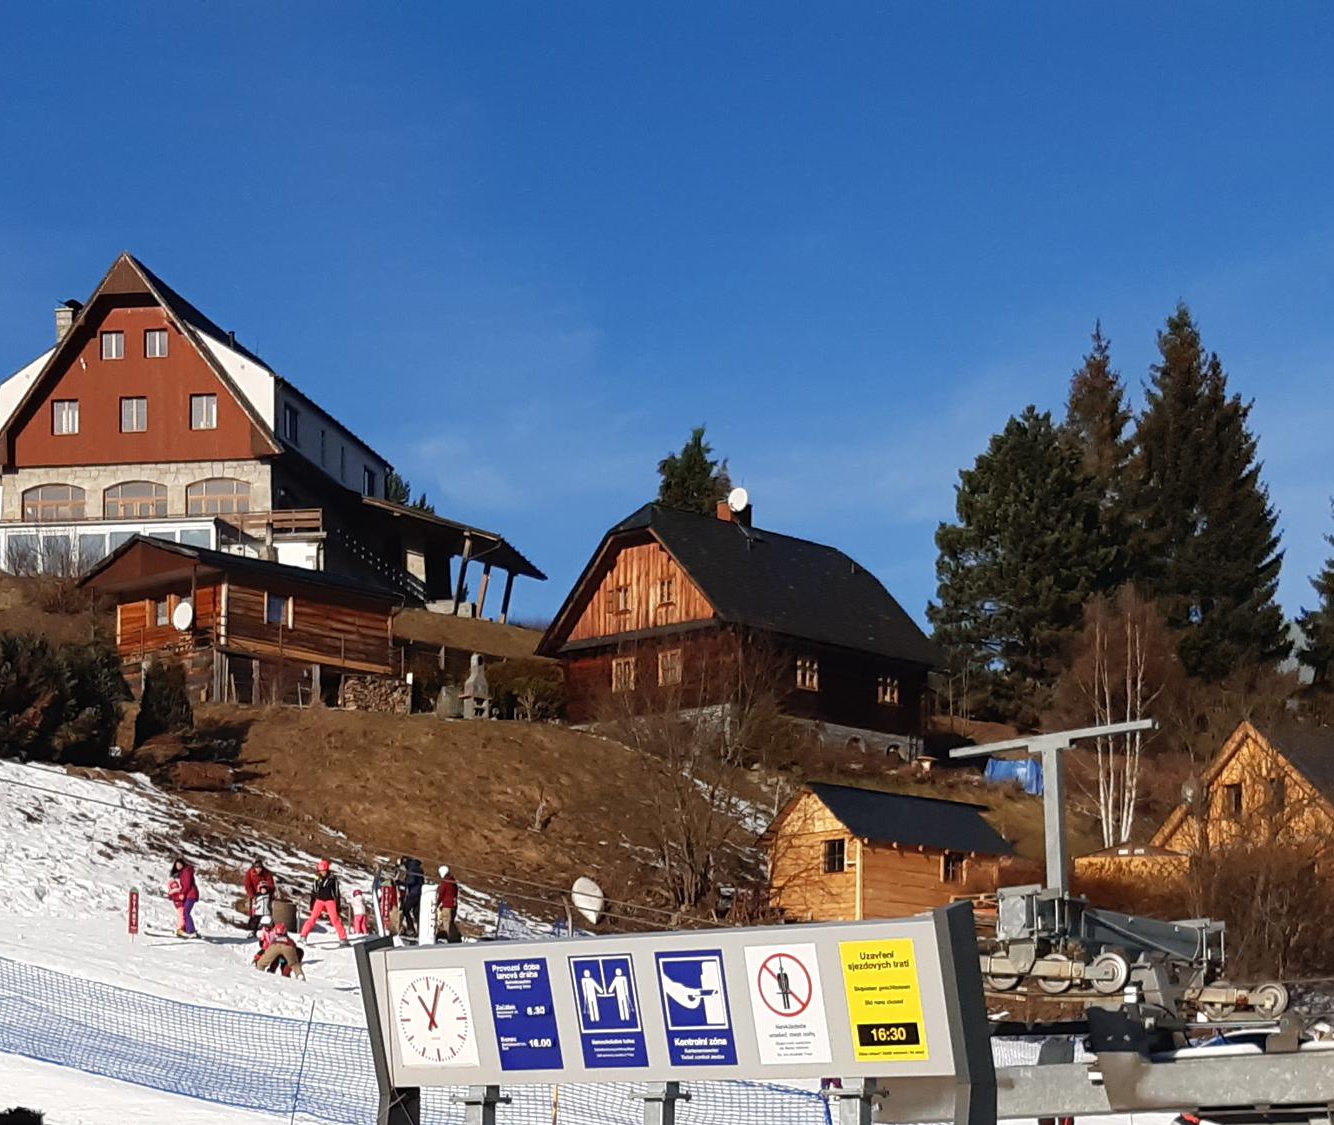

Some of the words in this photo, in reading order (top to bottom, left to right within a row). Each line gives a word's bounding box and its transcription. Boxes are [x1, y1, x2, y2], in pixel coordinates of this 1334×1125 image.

[859, 951, 895, 960] Uzavření
[848, 961, 892, 972] sjezdových
[870, 1027, 907, 1042] 16:30
[673, 1037, 708, 1047] Kontrolní
